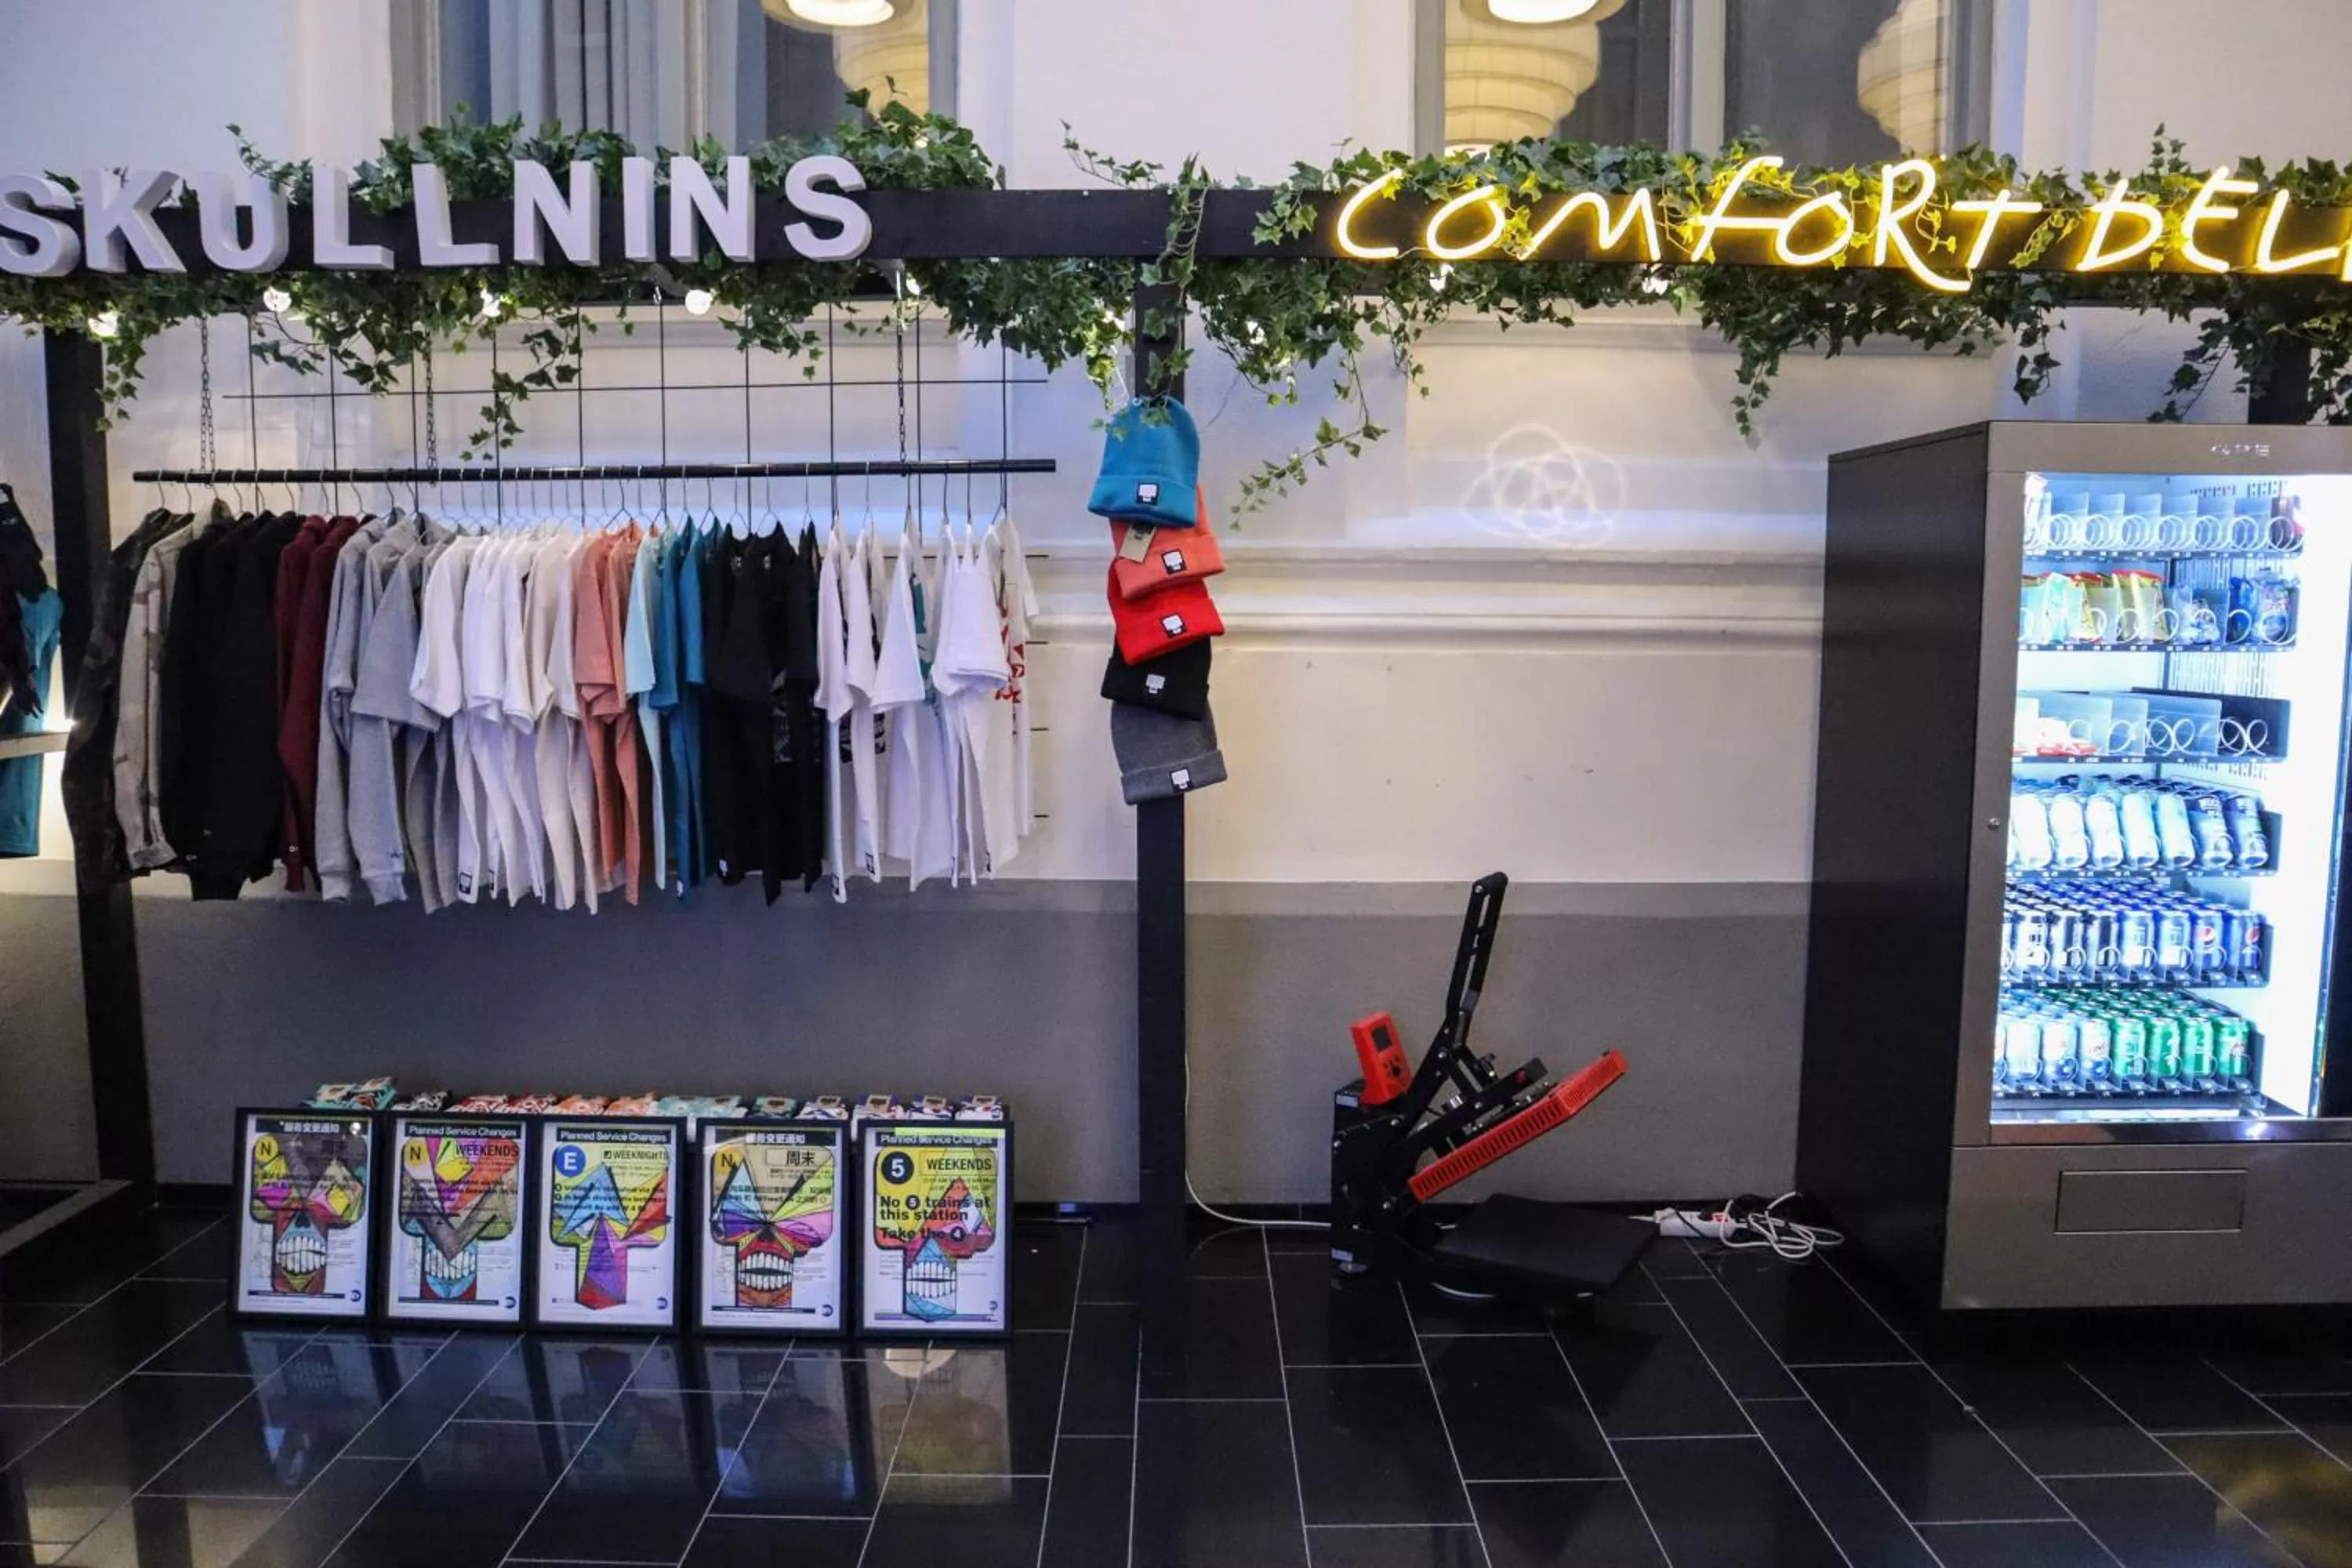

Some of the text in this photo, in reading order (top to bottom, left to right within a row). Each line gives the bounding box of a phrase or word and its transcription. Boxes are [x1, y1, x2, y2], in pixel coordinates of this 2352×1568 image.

[0, 156, 873, 276] SKULLNINS
[1334, 153, 2352, 292] COMFORT DEL
[408, 1125, 517, 1138] Planned Service Changes
[880, 1134, 916, 1144] Planned
[261, 1142, 271, 1156] N
[410, 1145, 421, 1160] N
[456, 1144, 519, 1156] WEEKENDS
[564, 1152, 578, 1171] E
[721, 1153, 732, 1167] N
[926, 1158, 992, 1171] WEEKENDS
[891, 1158, 905, 1178] 5
[880, 1196, 900, 1208] No
[925, 1196, 970, 1208] trains
[975, 1197, 991, 1208] at
[880, 1208, 968, 1221] this station
[880, 1227, 916, 1239] Take
[920, 1227, 946, 1240] the
